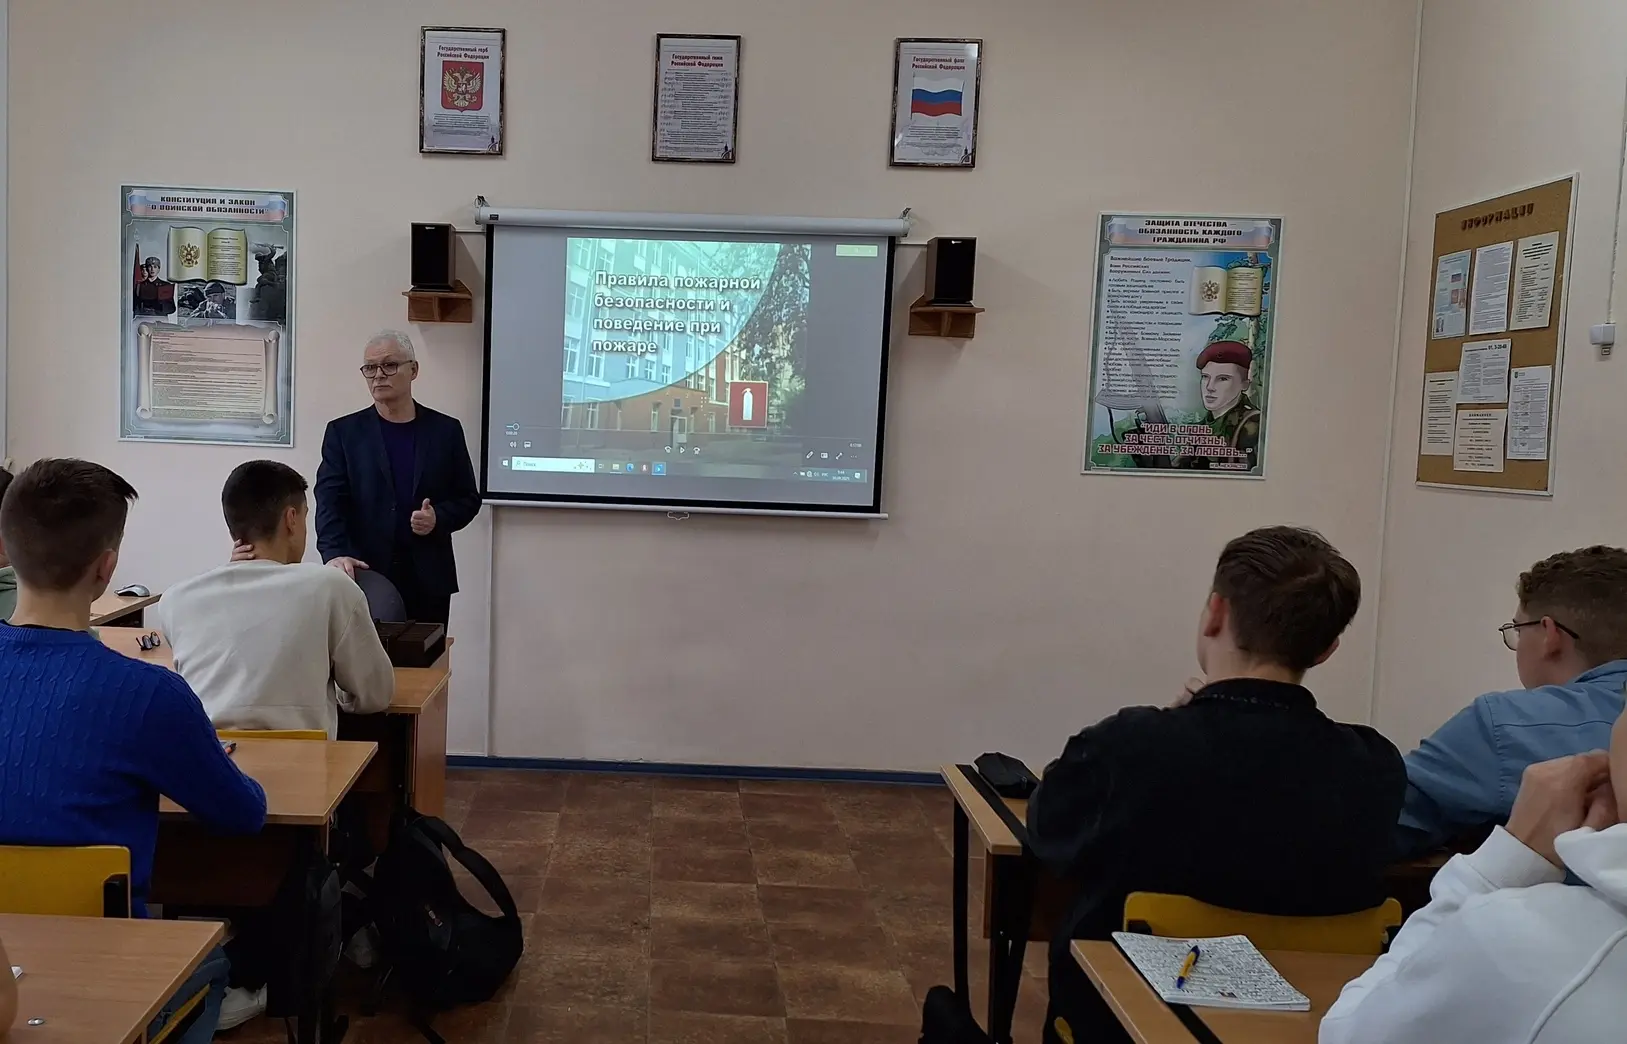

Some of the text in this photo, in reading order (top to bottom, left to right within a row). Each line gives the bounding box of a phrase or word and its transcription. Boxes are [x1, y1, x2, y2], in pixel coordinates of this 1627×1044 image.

[160, 196, 217, 204] КОНСТИТУЦИЯ
[595, 270, 760, 292] Правила пожарной
[594, 293, 730, 310] безопасности и
[593, 318, 720, 336] поведение при
[592, 340, 657, 356] пожаре
[1169, 424, 1177, 434] В
[1178, 425, 1212, 434] ОГОНЬ
[1124, 434, 1138, 443] ЗА
[1140, 434, 1173, 444] ЧЕСТЬ
[1098, 444, 1111, 453] ЗА
[1180, 446, 1194, 456] ЗА
